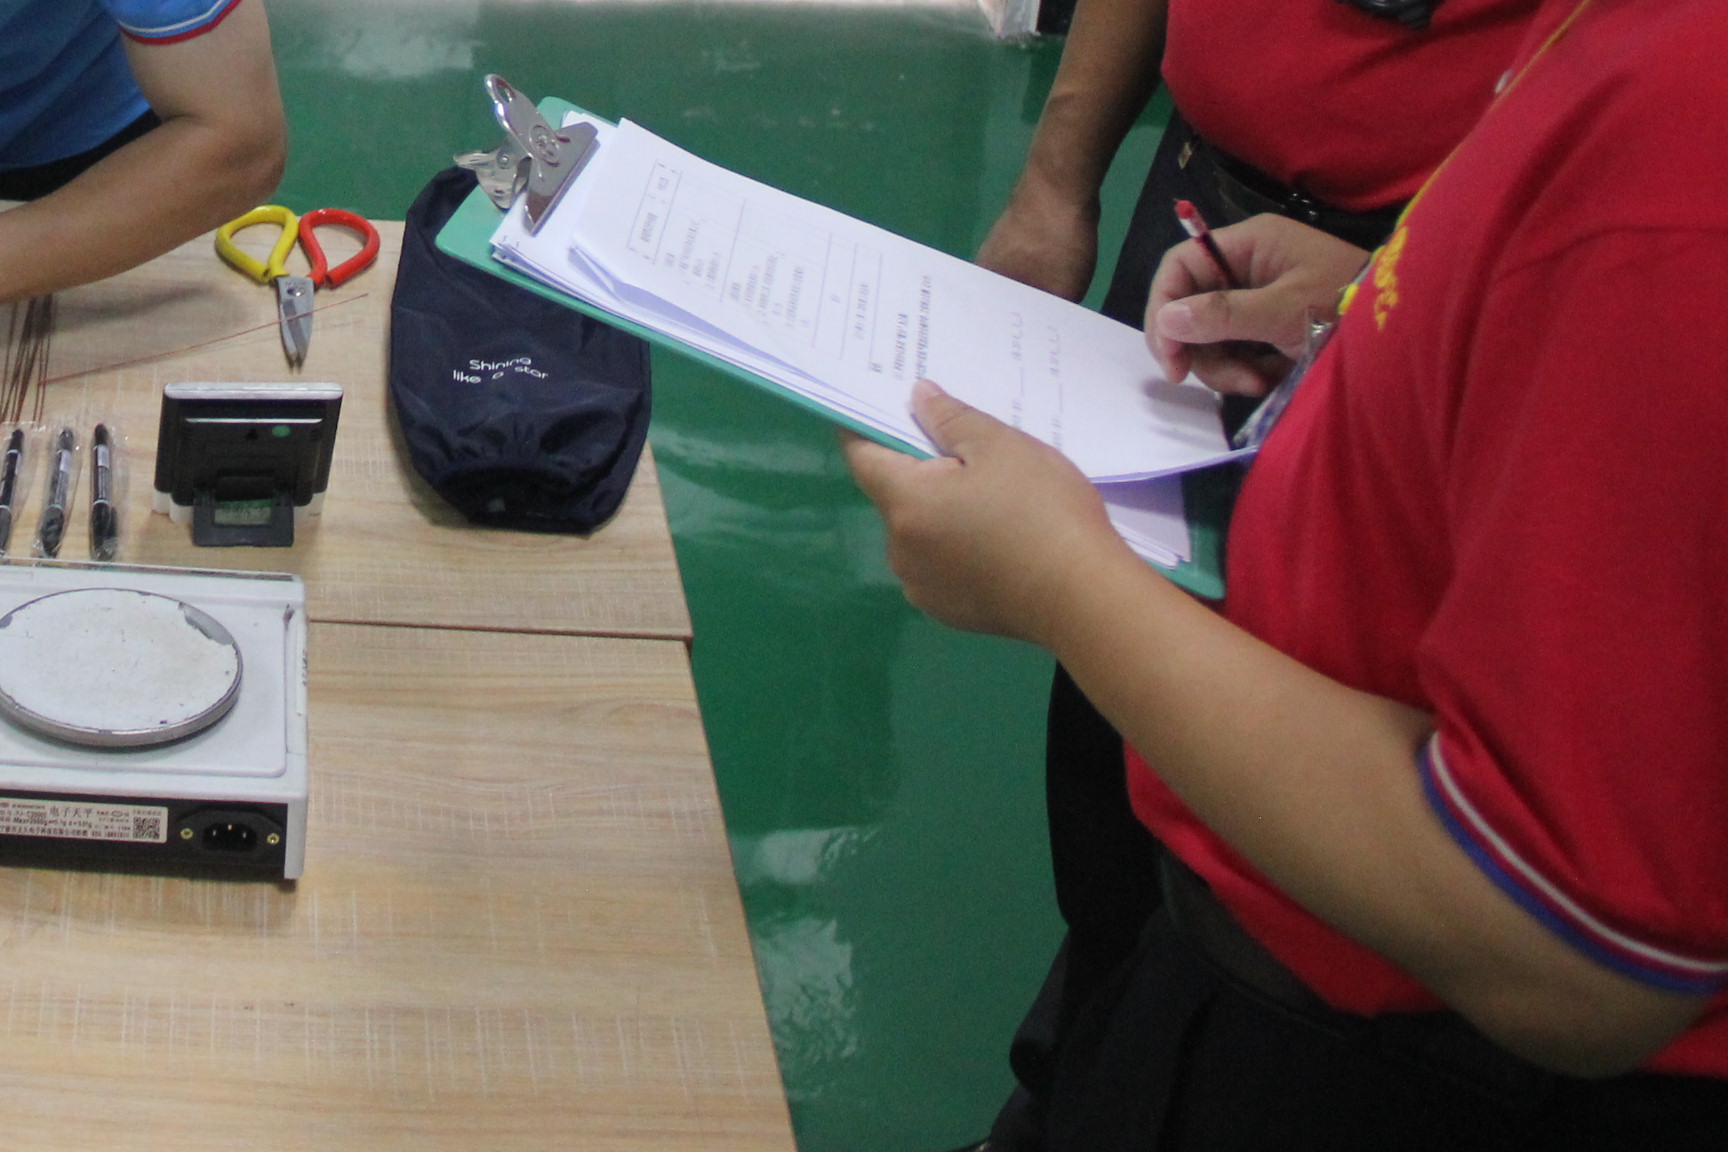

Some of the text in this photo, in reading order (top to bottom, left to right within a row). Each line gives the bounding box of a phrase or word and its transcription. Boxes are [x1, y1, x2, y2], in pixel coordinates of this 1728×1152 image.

[469, 357, 532, 371] Shining
[453, 369, 482, 384] like
[514, 366, 549, 380] star
